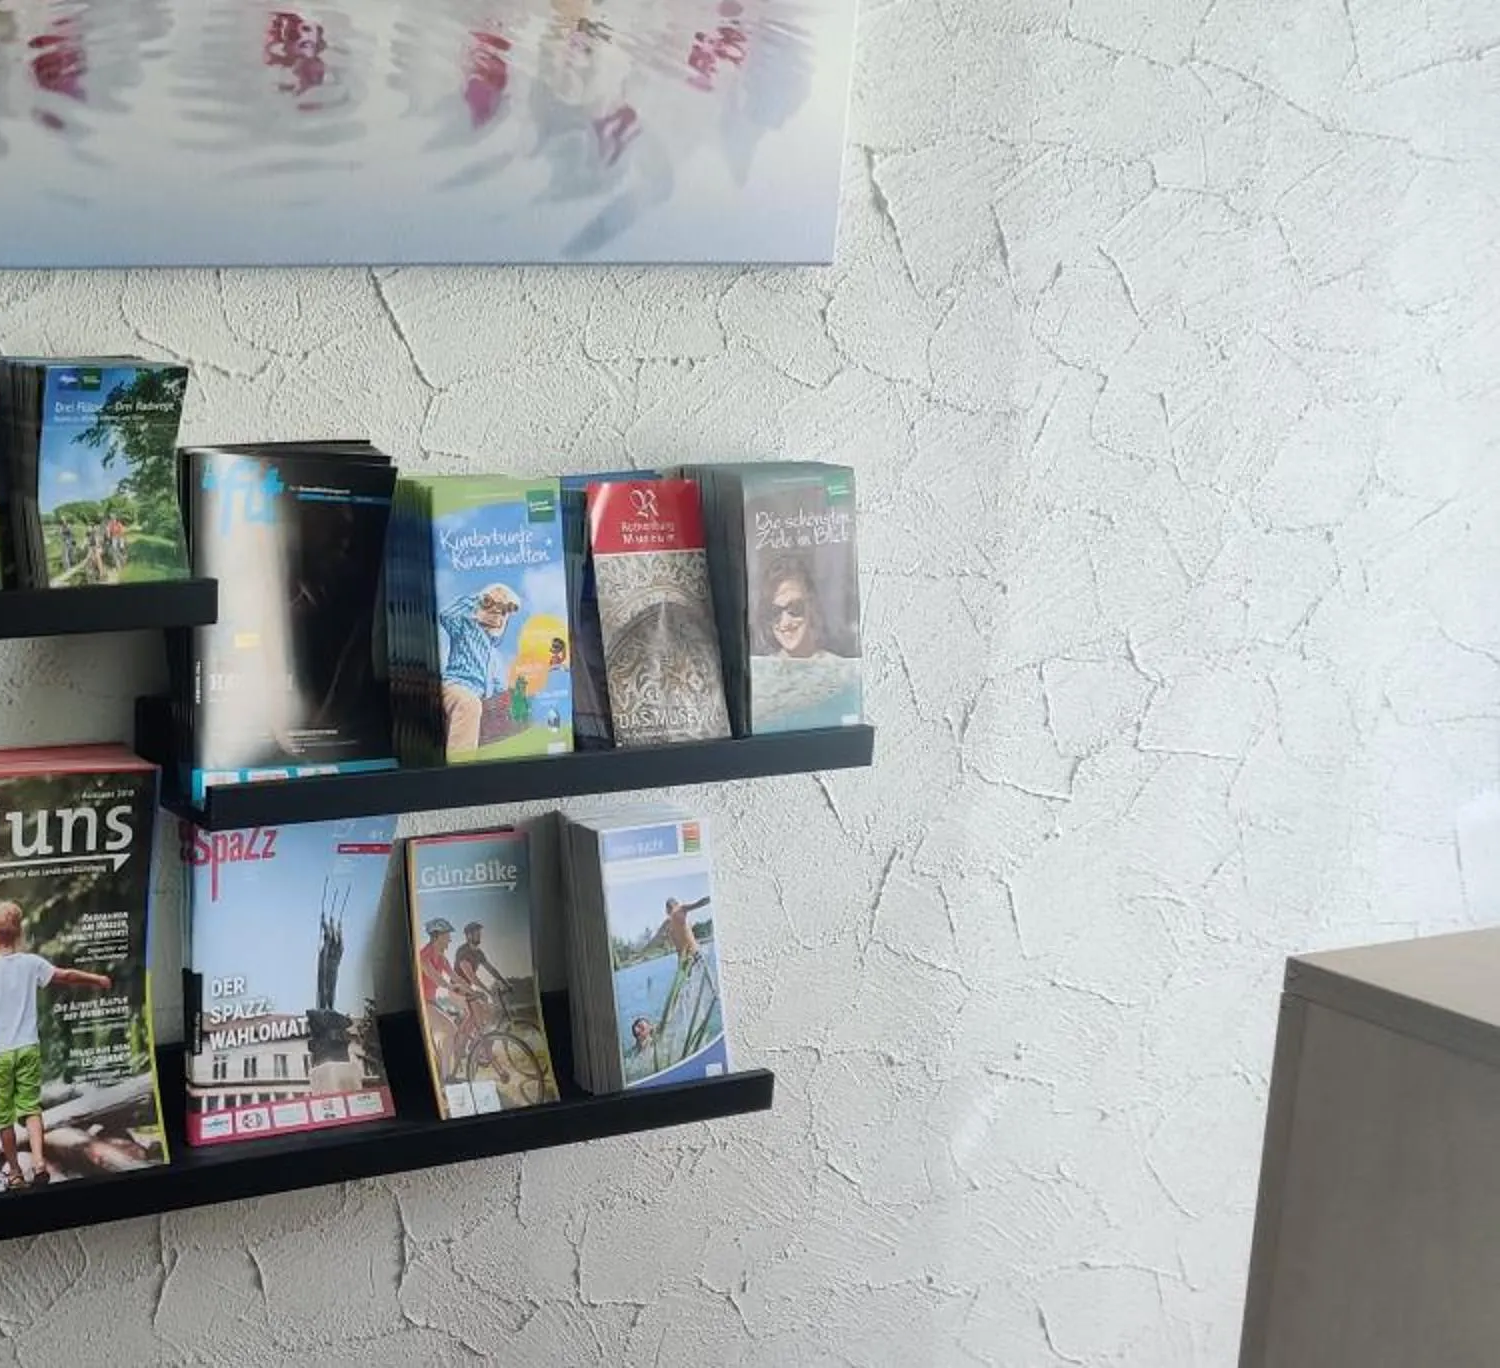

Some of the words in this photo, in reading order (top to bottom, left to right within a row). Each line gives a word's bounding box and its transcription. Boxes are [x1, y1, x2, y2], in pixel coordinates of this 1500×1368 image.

[756, 510, 781, 530] Die
[439, 524, 534, 550] Kunterbunte
[622, 533, 675, 545] Museum
[756, 528, 792, 549] Ziele
[451, 543, 551, 571] Kinderwelten
[420, 861, 517, 888] GünzBike
[211, 976, 246, 997] DER
[209, 1017, 309, 1051] WAHLOMAT
